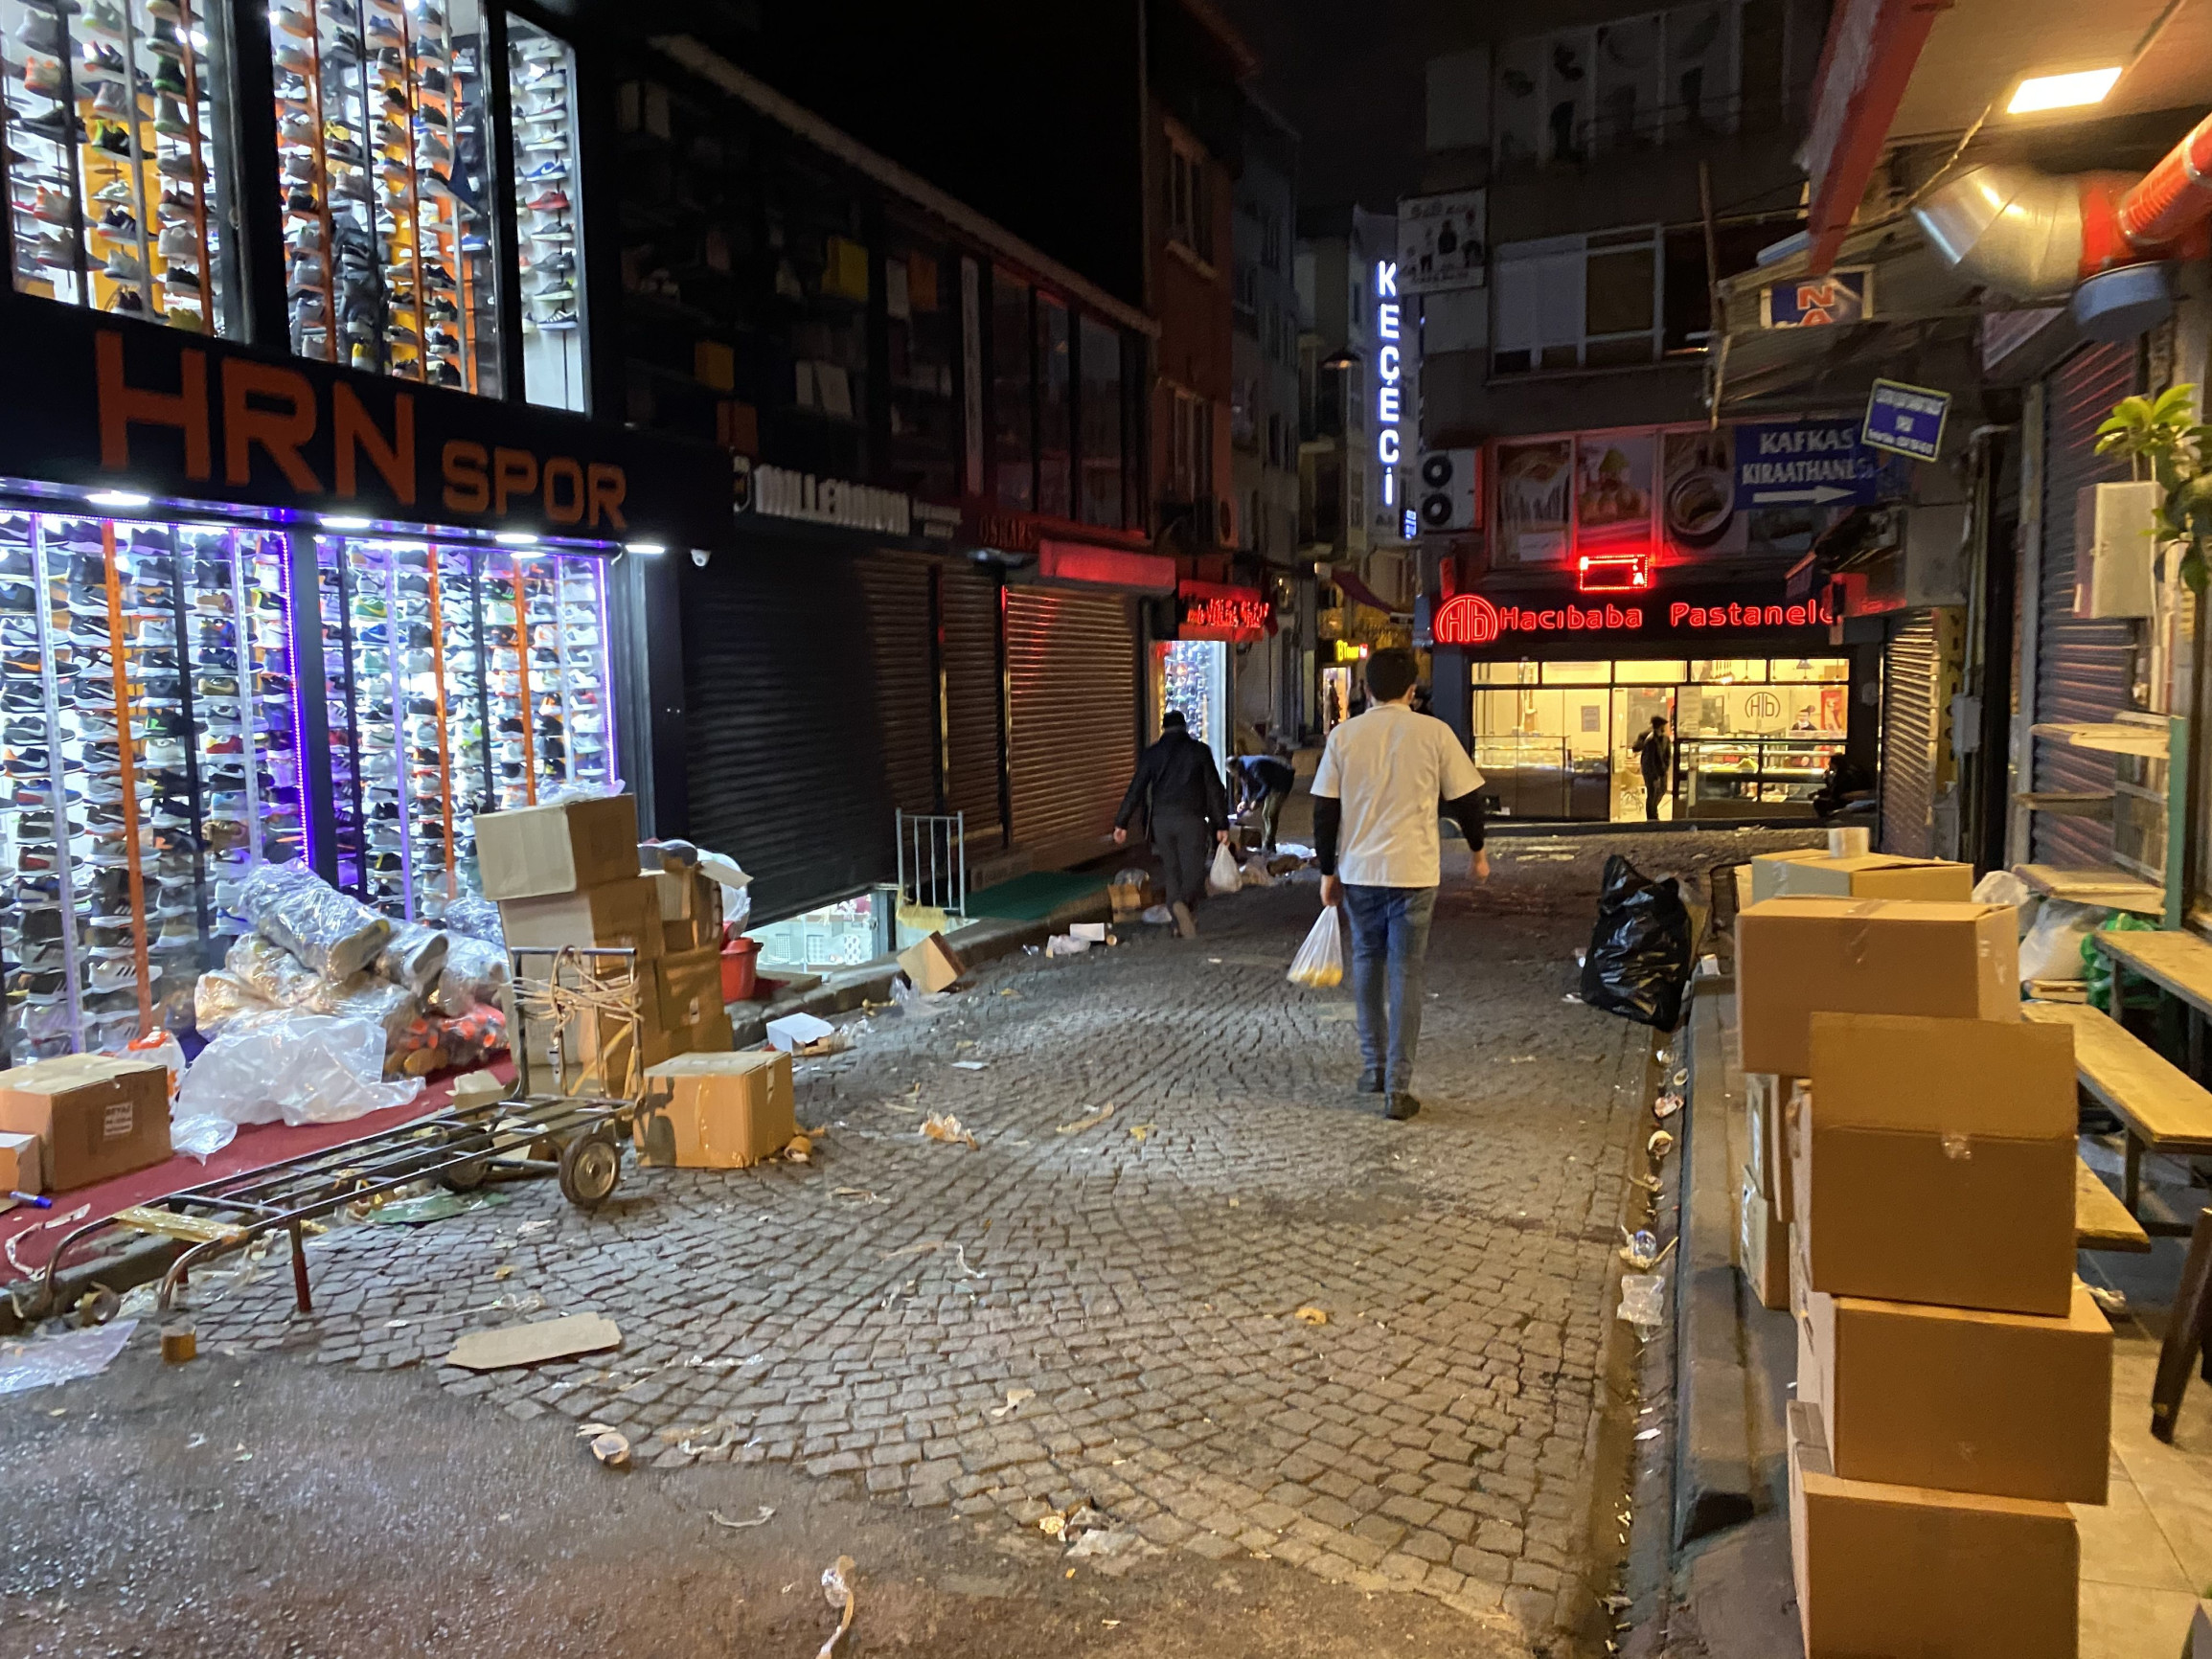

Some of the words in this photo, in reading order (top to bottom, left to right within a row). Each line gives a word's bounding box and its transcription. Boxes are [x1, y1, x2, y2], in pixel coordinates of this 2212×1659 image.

[97, 330, 418, 507] HRN
[442, 440, 627, 531] SPOR
[1759, 427, 1856, 456] KAFKAS
